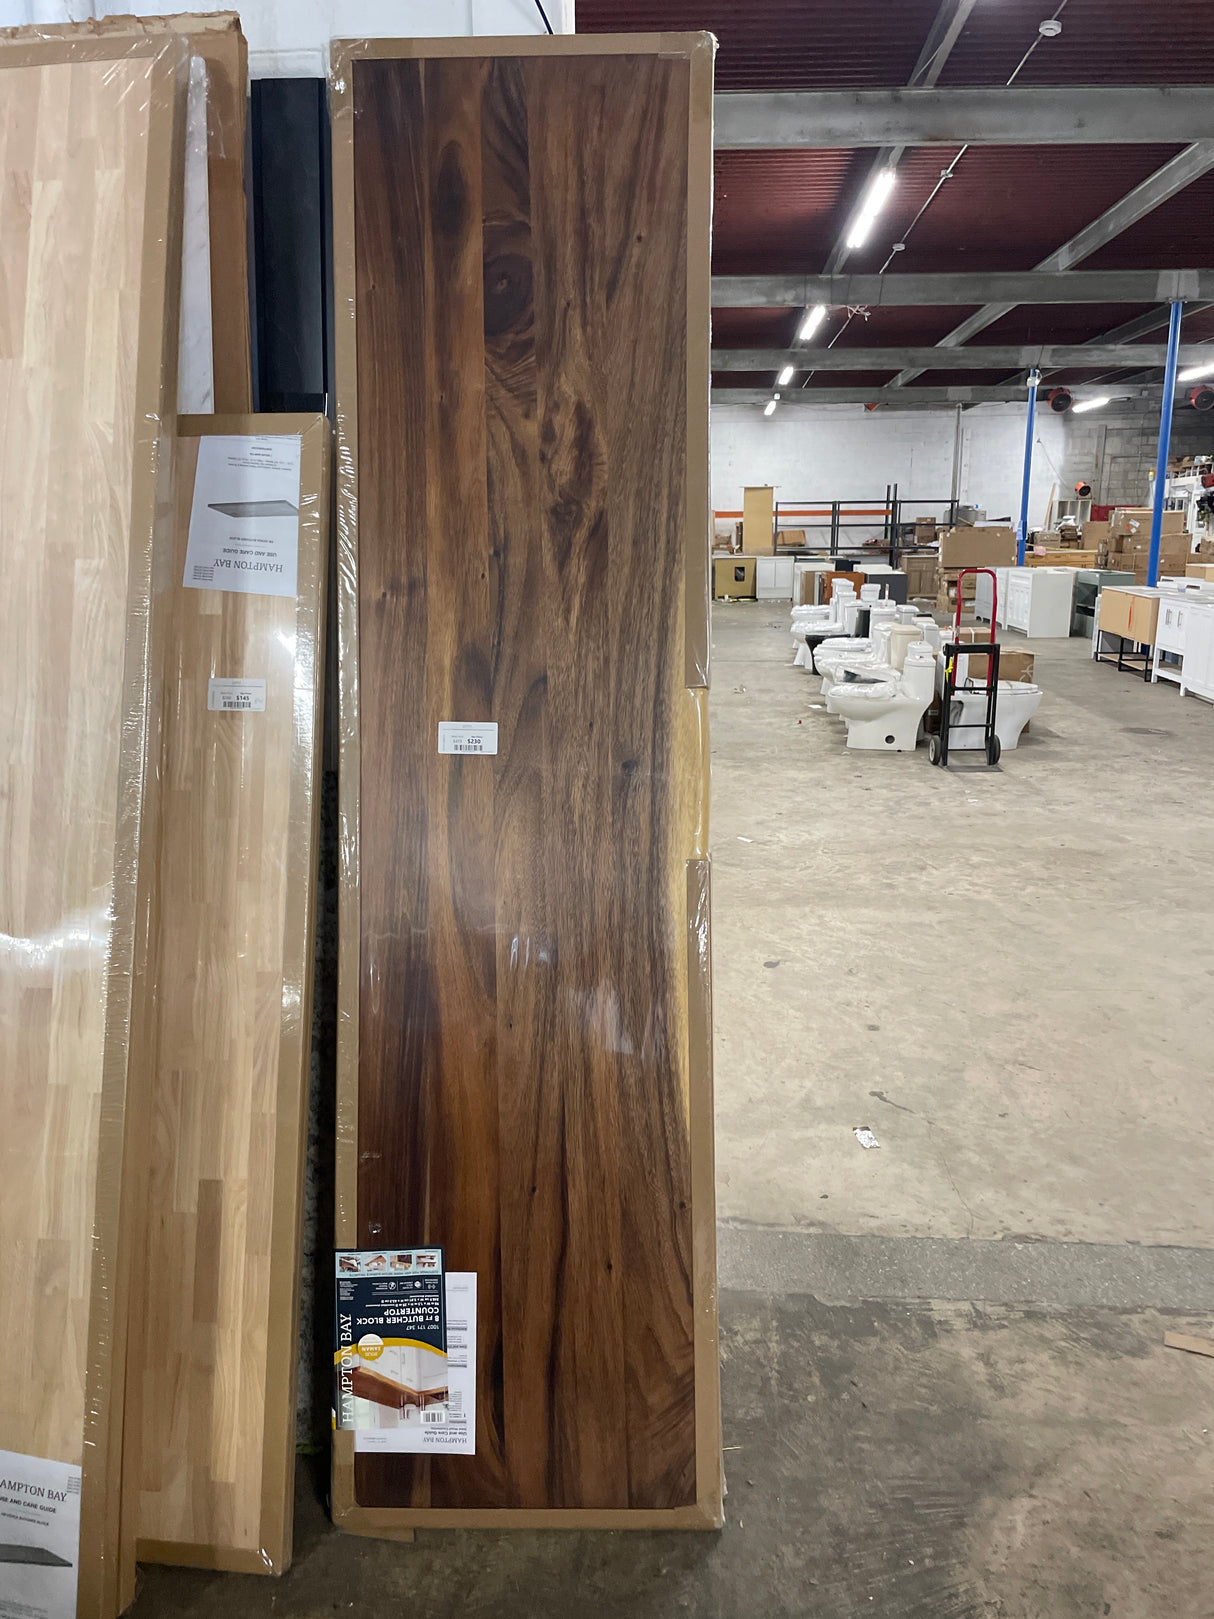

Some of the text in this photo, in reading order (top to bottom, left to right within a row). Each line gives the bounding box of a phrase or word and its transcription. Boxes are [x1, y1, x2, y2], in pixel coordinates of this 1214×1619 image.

[213, 558, 283, 573] HAMPTON BAY
[384, 1307, 440, 1316] COUNTERTOP
[356, 1317, 384, 1325] BLOCK
[385, 1315, 424, 1324] BUTCHER
[340, 1313, 352, 1342] BAY
[341, 1345, 353, 1423] HAMPTON
[47, 1489, 67, 1502] BAY
